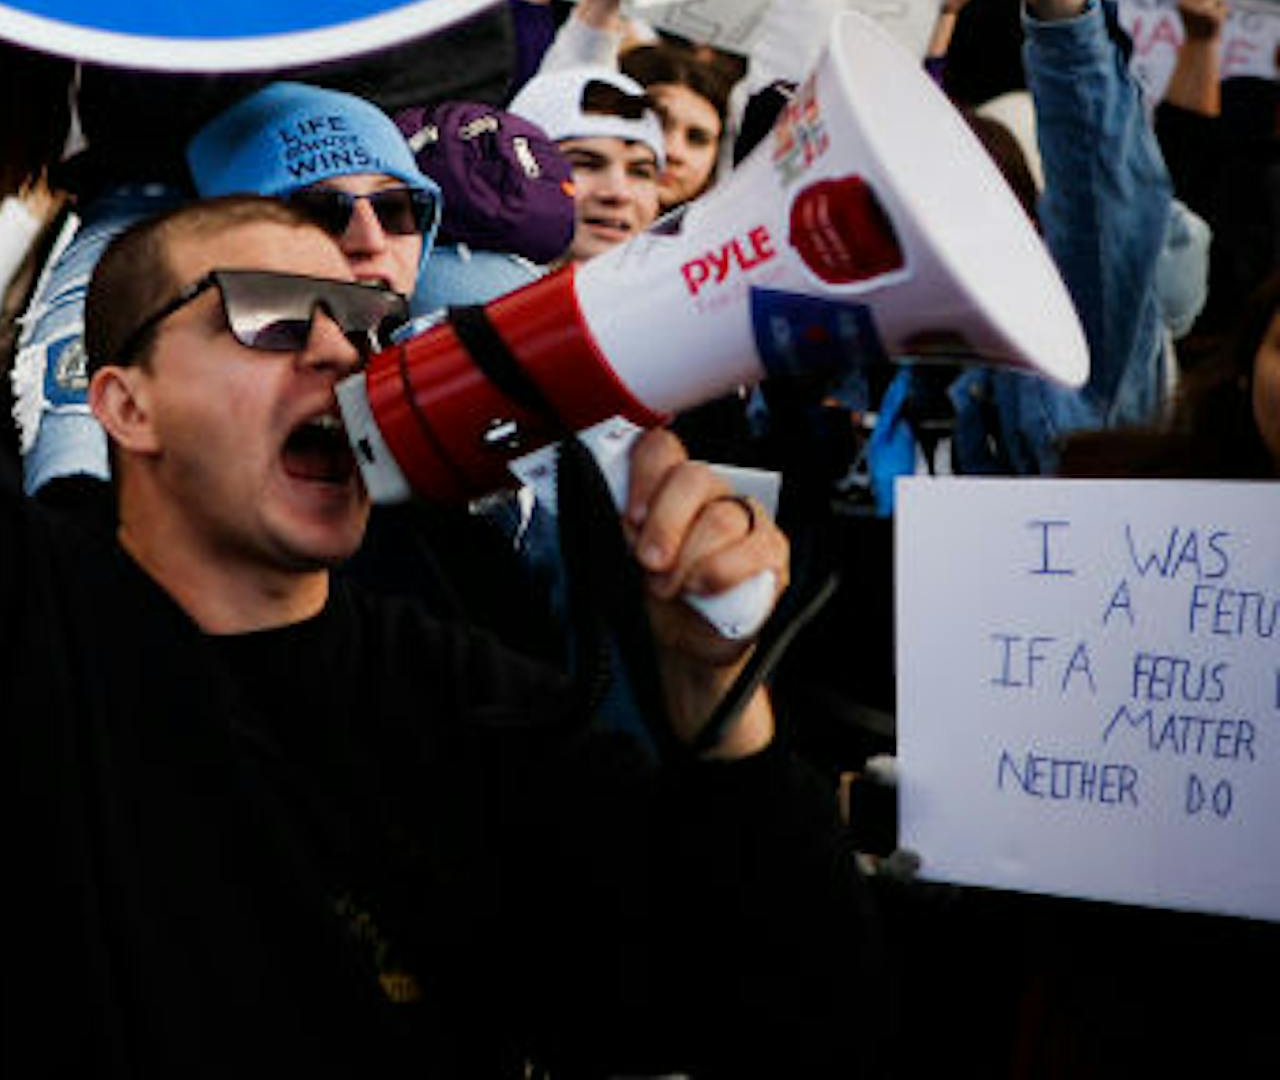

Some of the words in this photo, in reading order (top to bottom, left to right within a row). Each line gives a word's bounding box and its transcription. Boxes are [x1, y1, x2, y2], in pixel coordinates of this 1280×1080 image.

[279, 115, 348, 143] LIFE
[681, 224, 776, 296] PYLE
[1026, 521, 1074, 575] I
[1125, 523, 1234, 579] WAS
[1102, 579, 1136, 626] A
[1188, 584, 1280, 639] FETU
[989, 633, 1053, 689] IF
[1061, 643, 1097, 694] A
[1131, 652, 1228, 704] FETUS
[1102, 705, 1256, 761] MATTER
[997, 748, 1140, 808] NEITHER
[1186, 774, 1234, 819] DO
